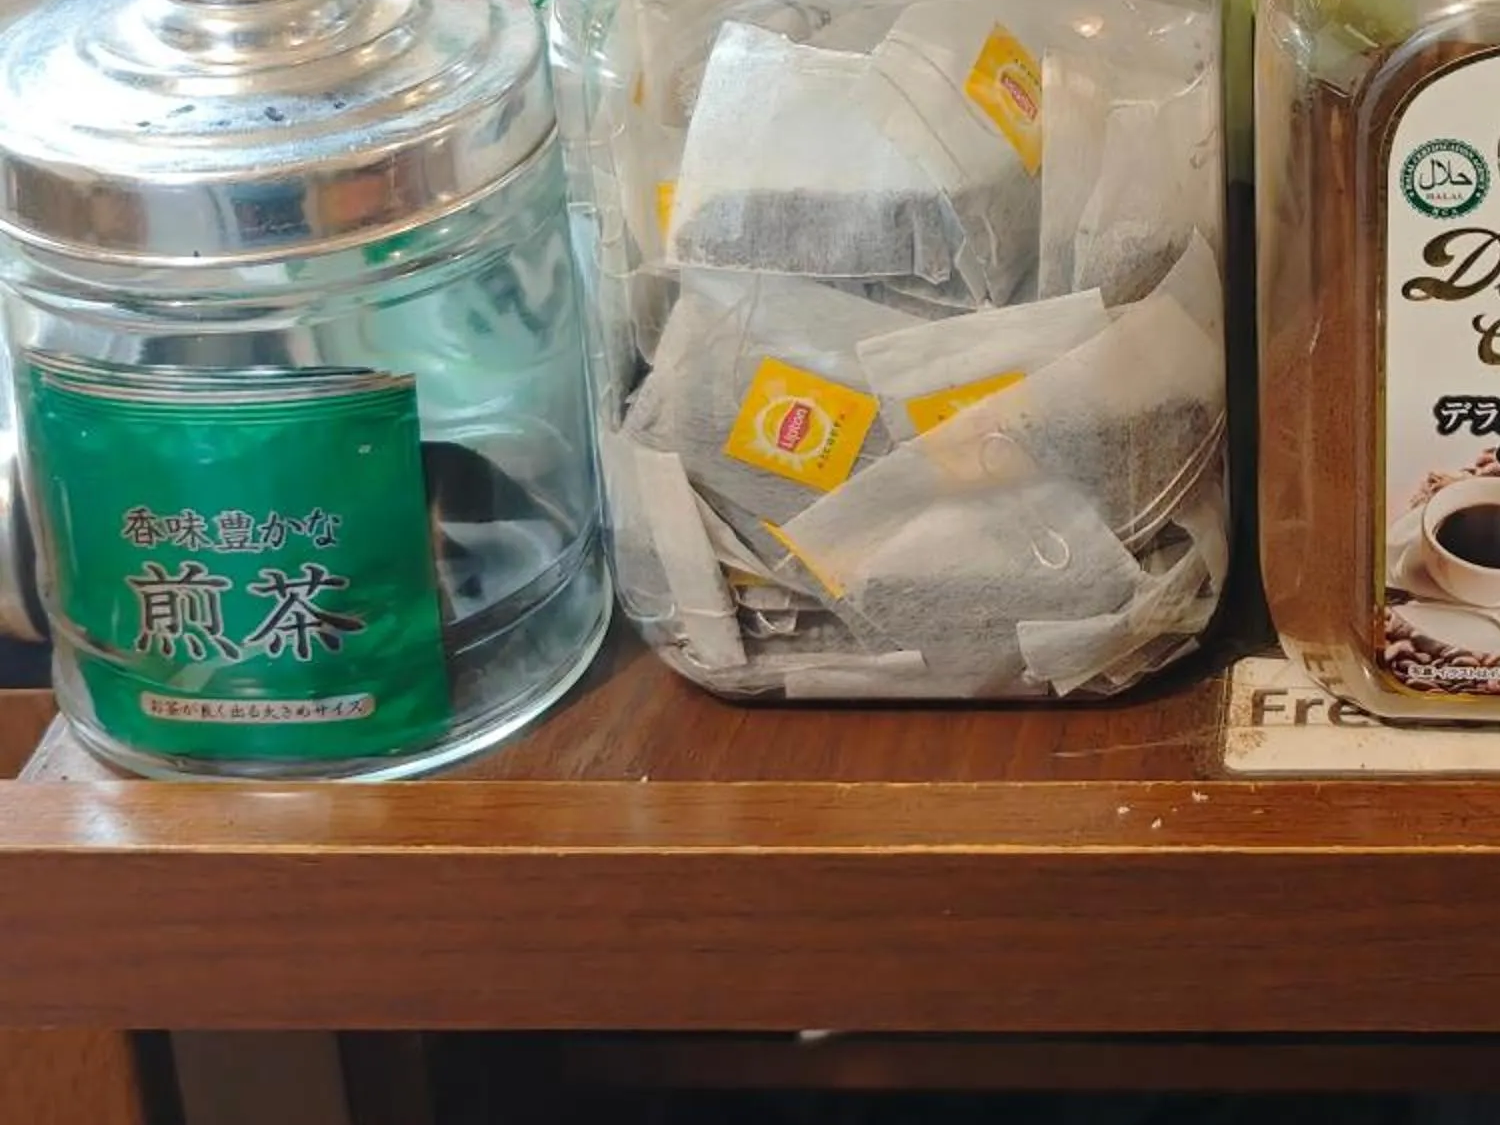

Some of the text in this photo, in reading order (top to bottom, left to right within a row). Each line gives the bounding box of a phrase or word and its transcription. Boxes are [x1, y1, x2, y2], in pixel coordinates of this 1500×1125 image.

[122, 507, 343, 553] 香味豊かな
[126, 562, 367, 661] 煎茶
[1251, 688, 1372, 726] Fre
